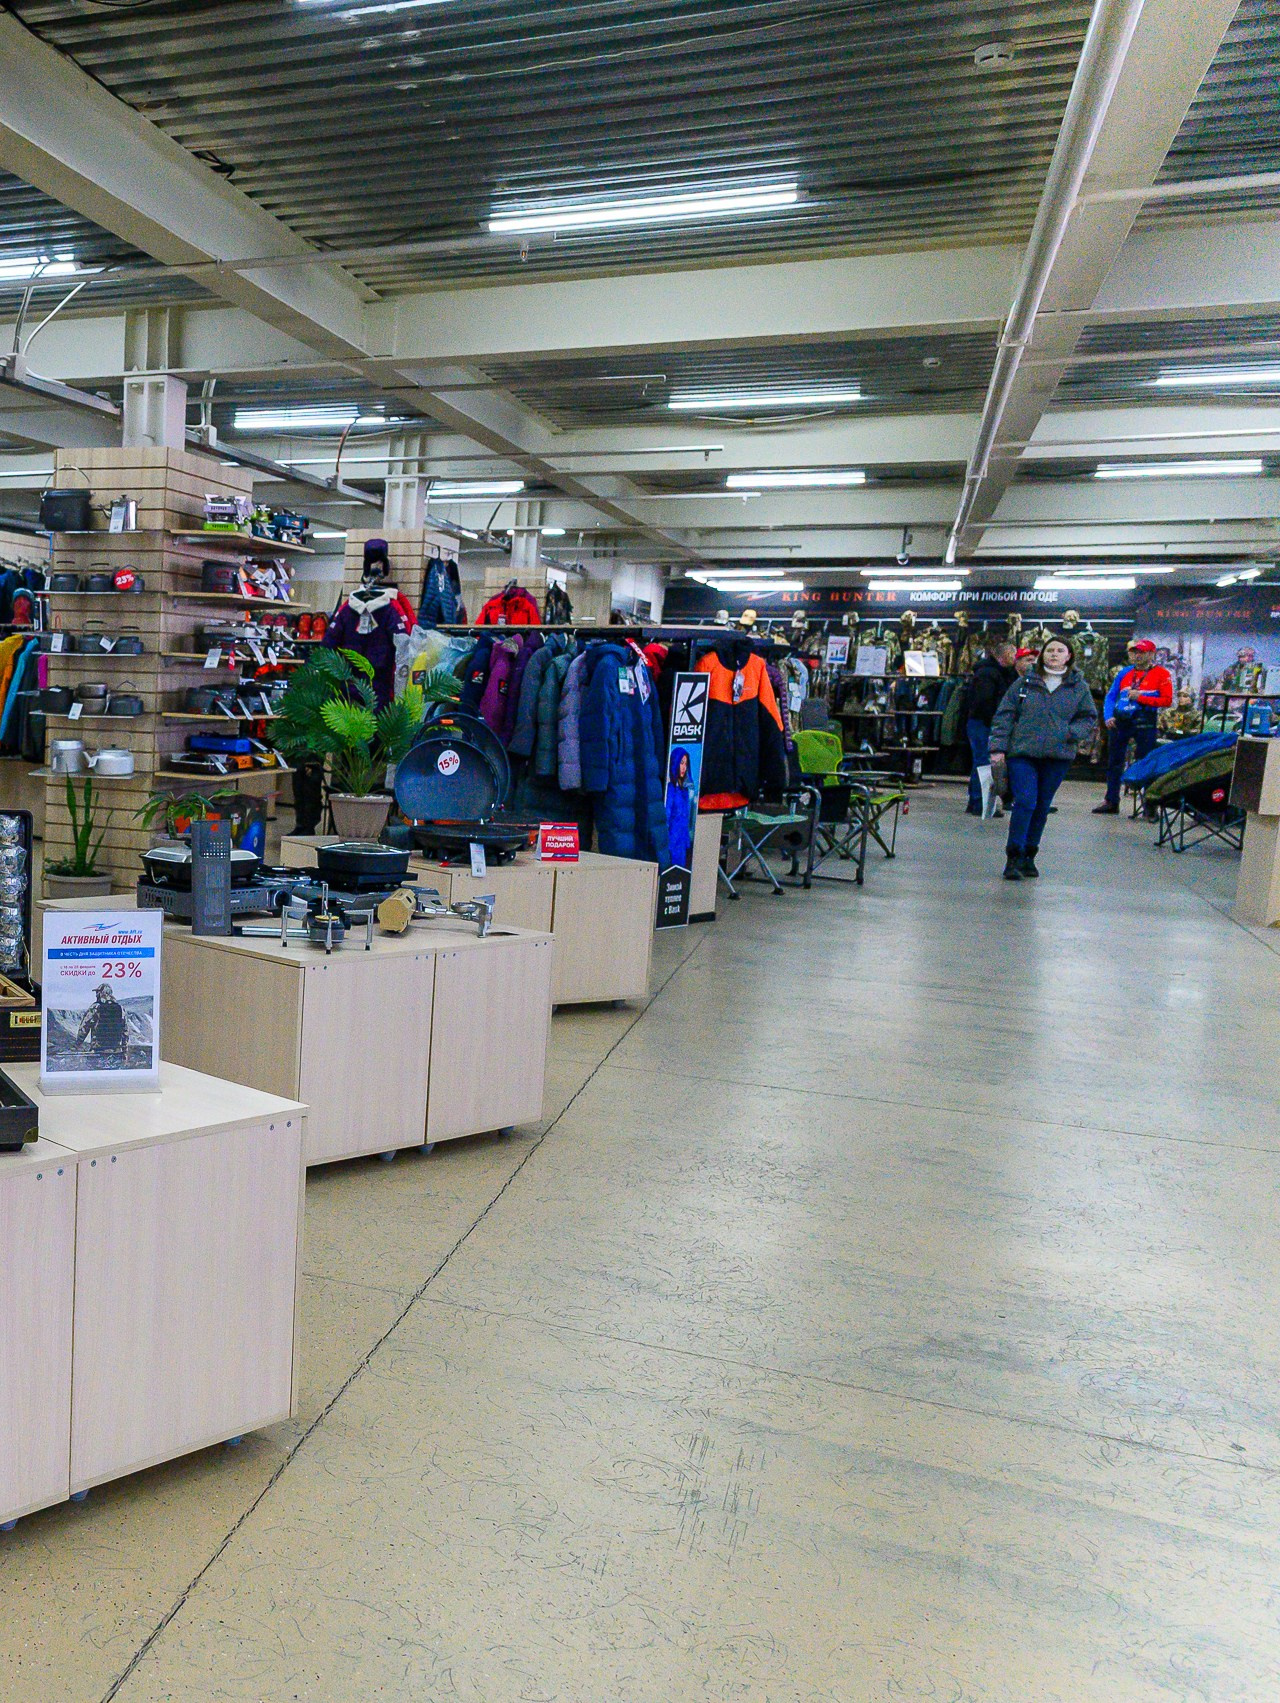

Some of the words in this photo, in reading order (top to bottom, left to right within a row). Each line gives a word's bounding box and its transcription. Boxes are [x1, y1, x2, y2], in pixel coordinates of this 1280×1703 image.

[781, 592, 821, 602] KING
[830, 592, 897, 602] HUNTER
[910, 591, 957, 602] КОМФОРТ
[959, 591, 979, 602] ПРИ
[981, 590, 1017, 601] ЛЮБОЙ
[1020, 591, 1059, 602] ПОГОДЕ
[673, 724, 702, 736] BASK
[438, 755, 459, 771] 15%
[61, 934, 110, 945] АКТИВНЫЙ
[111, 934, 143, 945] ОТДЫХ
[102, 962, 142, 978] 23%
